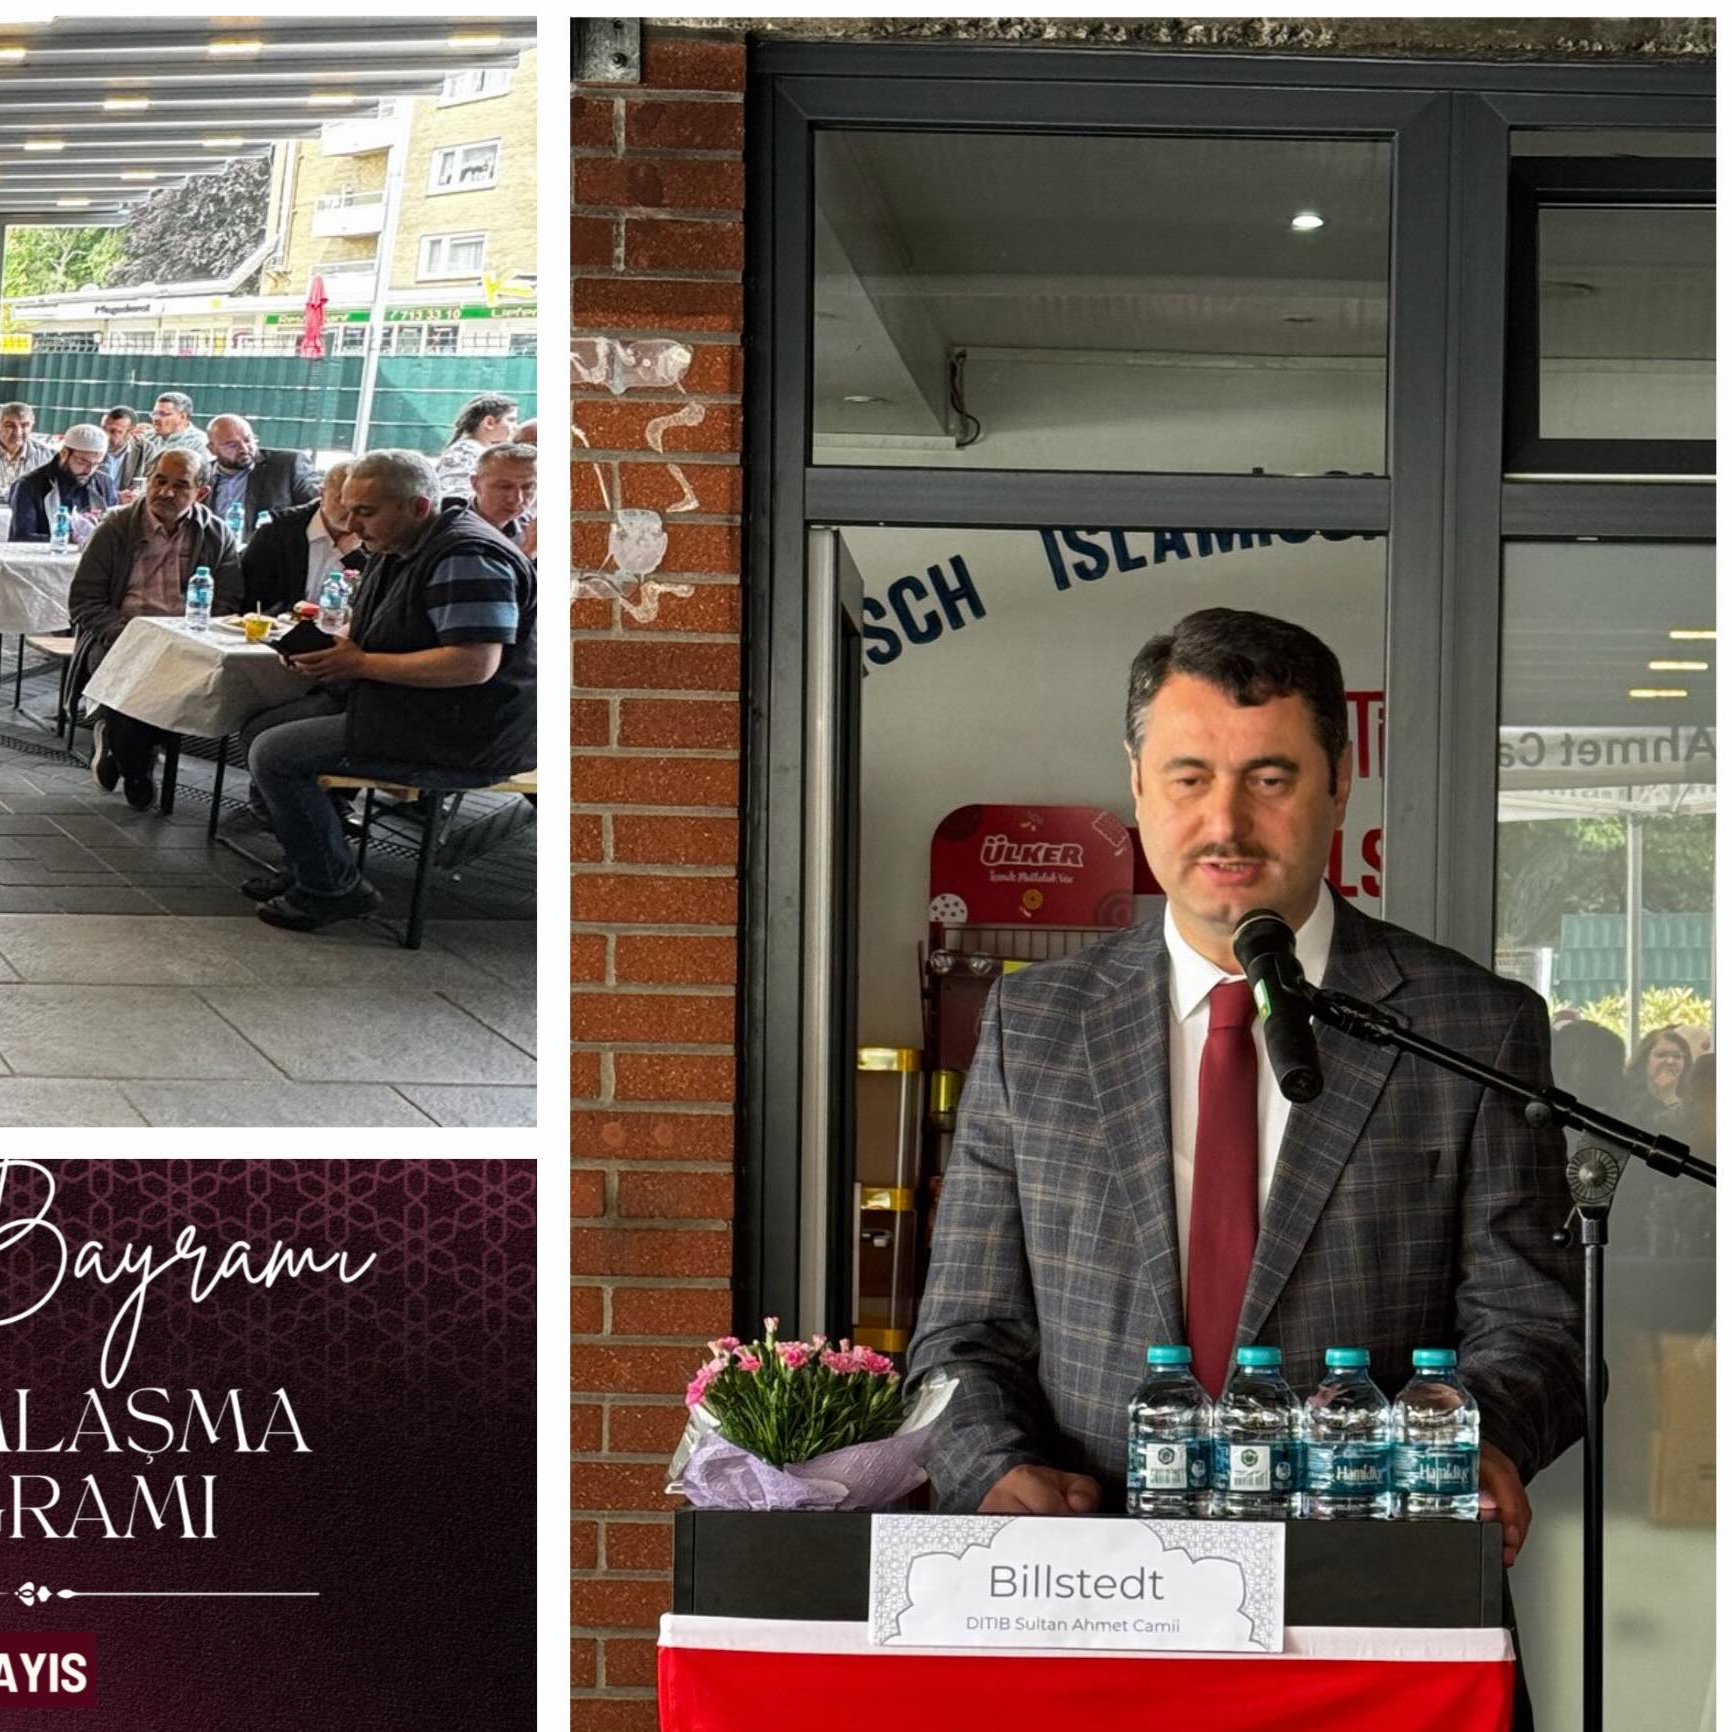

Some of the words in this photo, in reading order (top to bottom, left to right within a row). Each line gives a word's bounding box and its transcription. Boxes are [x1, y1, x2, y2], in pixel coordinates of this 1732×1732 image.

[980, 834, 1084, 868] ÜLKER
[990, 1564, 1165, 1600] Billstedt
[966, 1616, 1011, 1631] DITIB
[1015, 1617, 1068, 1632] Sultan
[1072, 1618, 1129, 1633] Ahmet
[1133, 1619, 1180, 1634] Camii
